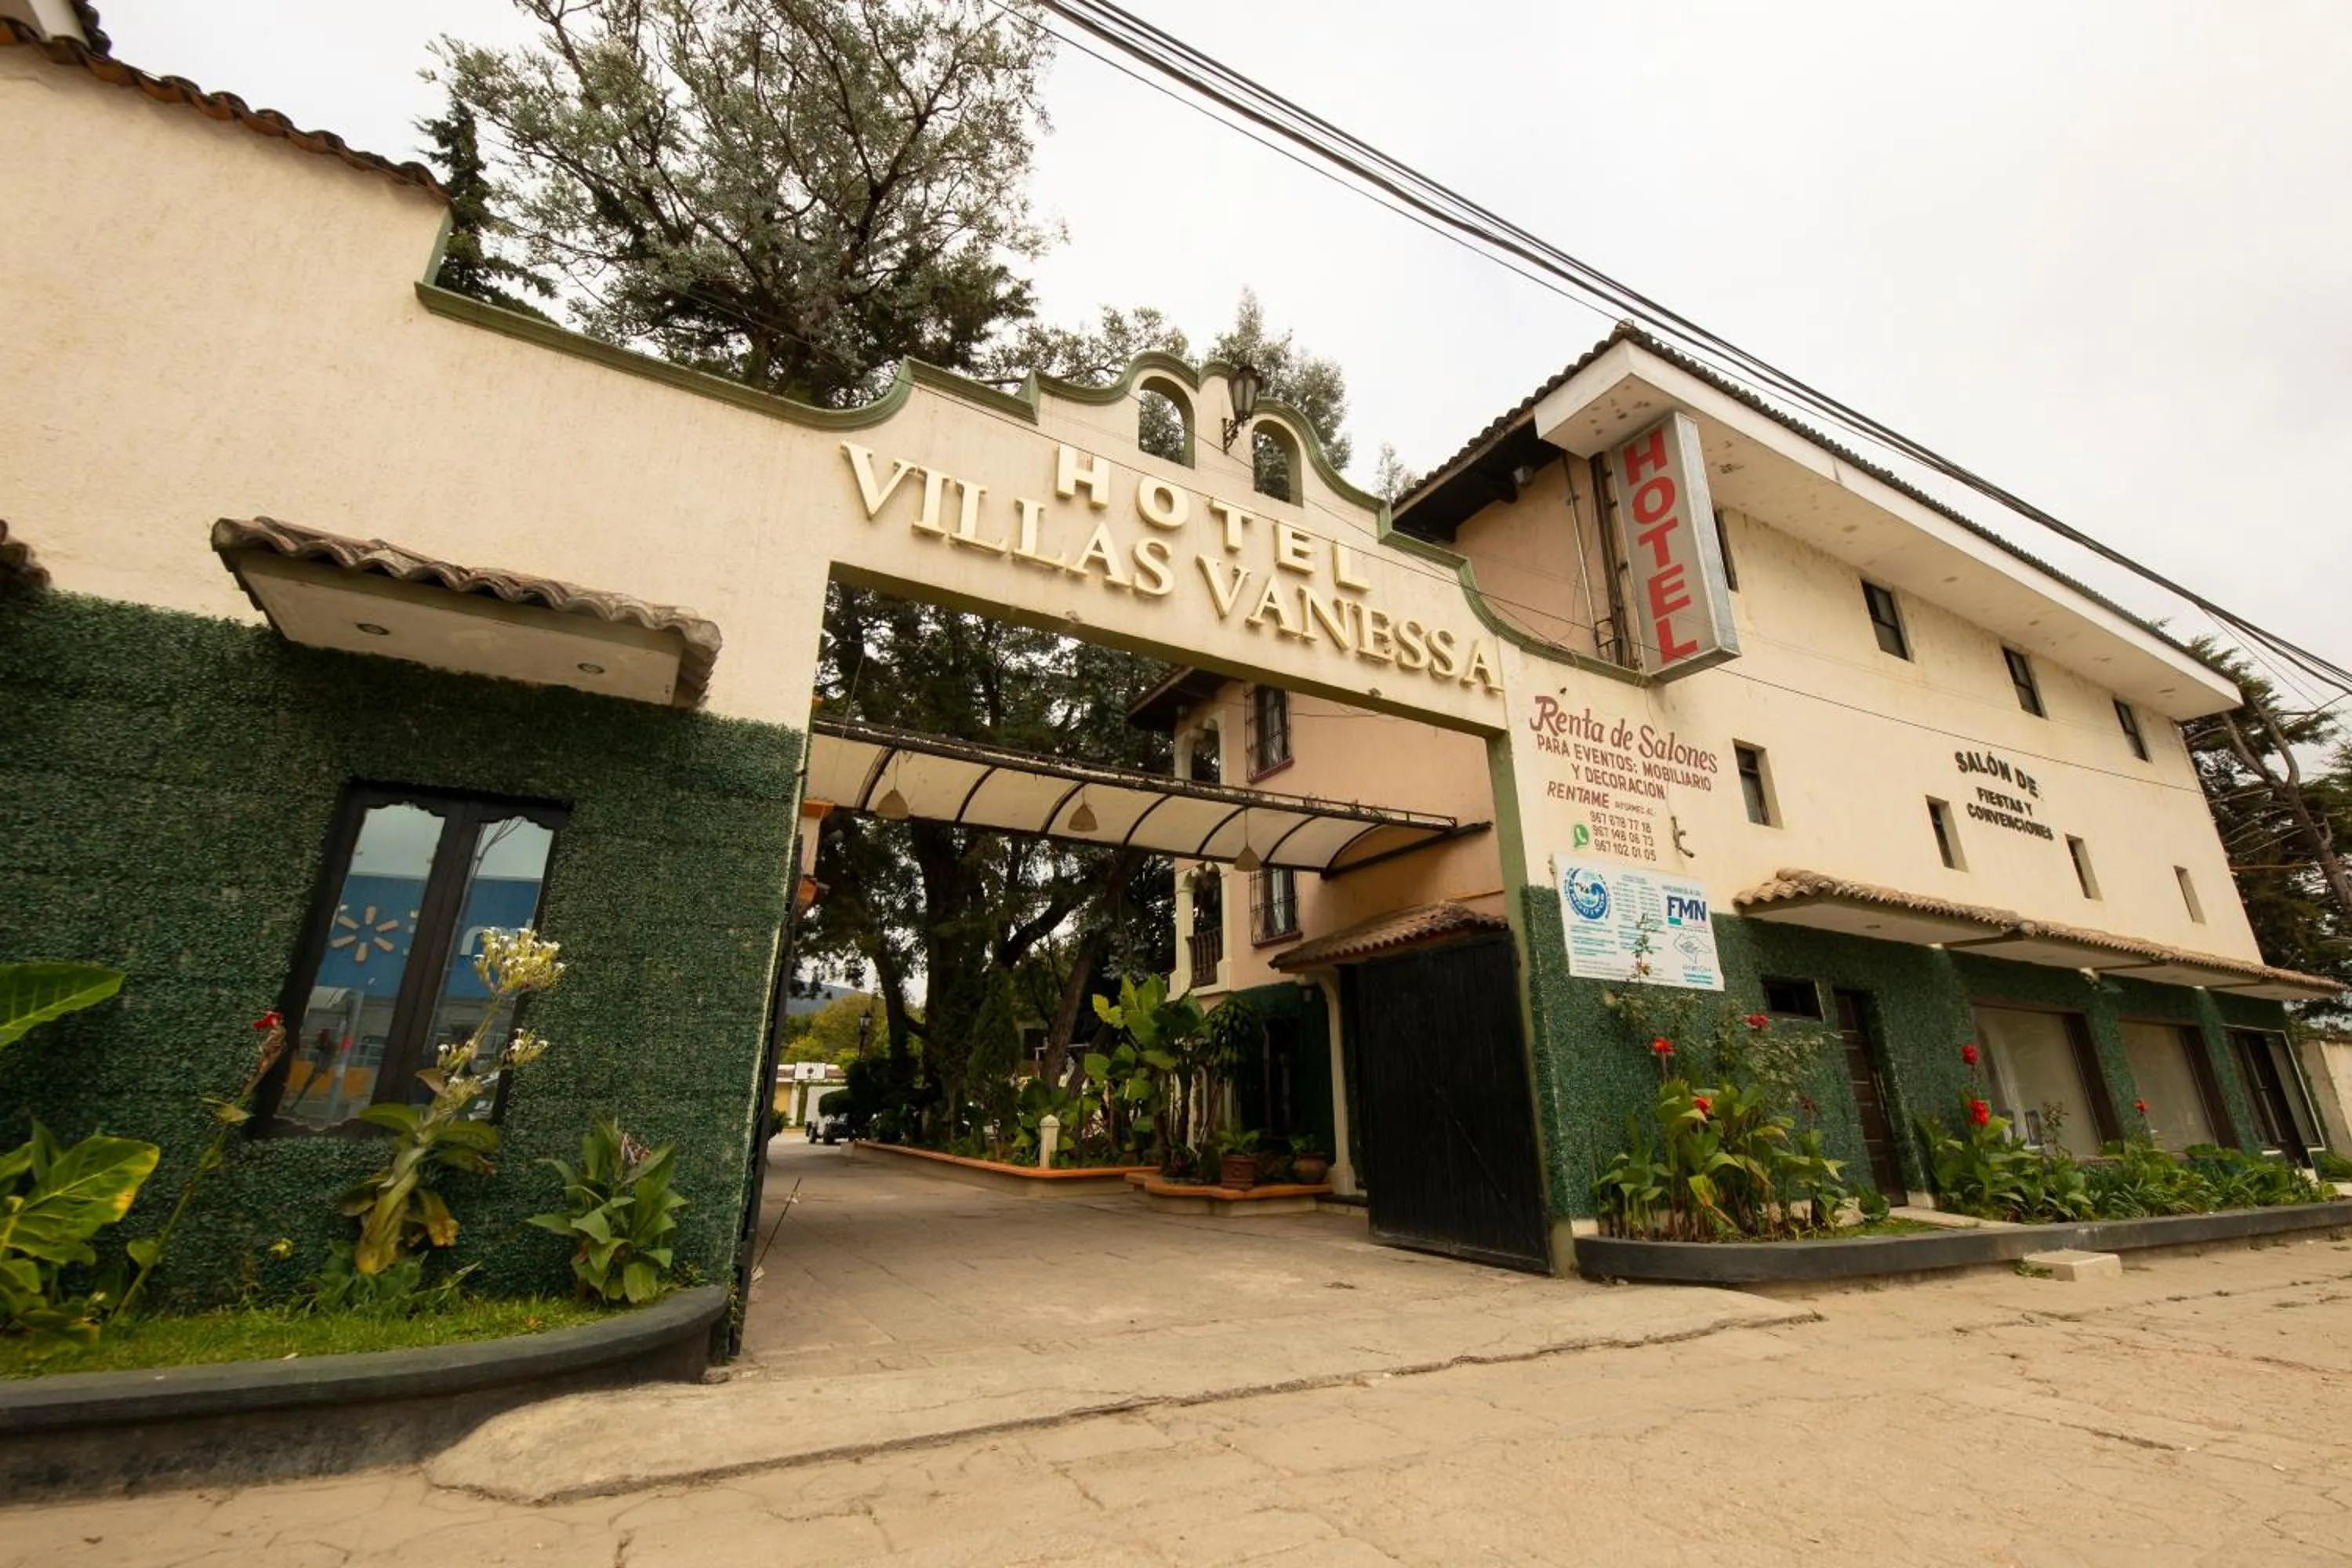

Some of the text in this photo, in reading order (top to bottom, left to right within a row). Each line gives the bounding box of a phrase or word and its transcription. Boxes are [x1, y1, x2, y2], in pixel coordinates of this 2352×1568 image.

[1054, 442, 1372, 592] HOTEL
[1621, 427, 1698, 665] HOTEL
[840, 439, 1504, 695] VILLAS VANESSA
[1530, 695, 1718, 774] Renta de Salones
[1537, 734, 1570, 757] PARA
[1642, 761, 1711, 792] MOBILIARIO
[1571, 764, 1665, 800] Y DECORACIÓN
[1955, 751, 2039, 799] SALÓN DE
[1547, 781, 1610, 808] RENTAME
[1976, 786, 2033, 816] FIESTAS Y
[1627, 818, 1639, 831] 77
[1966, 802, 2053, 840] CONVENCIONES
[1613, 842, 1630, 857] 102
[1667, 895, 1707, 921] FMN
